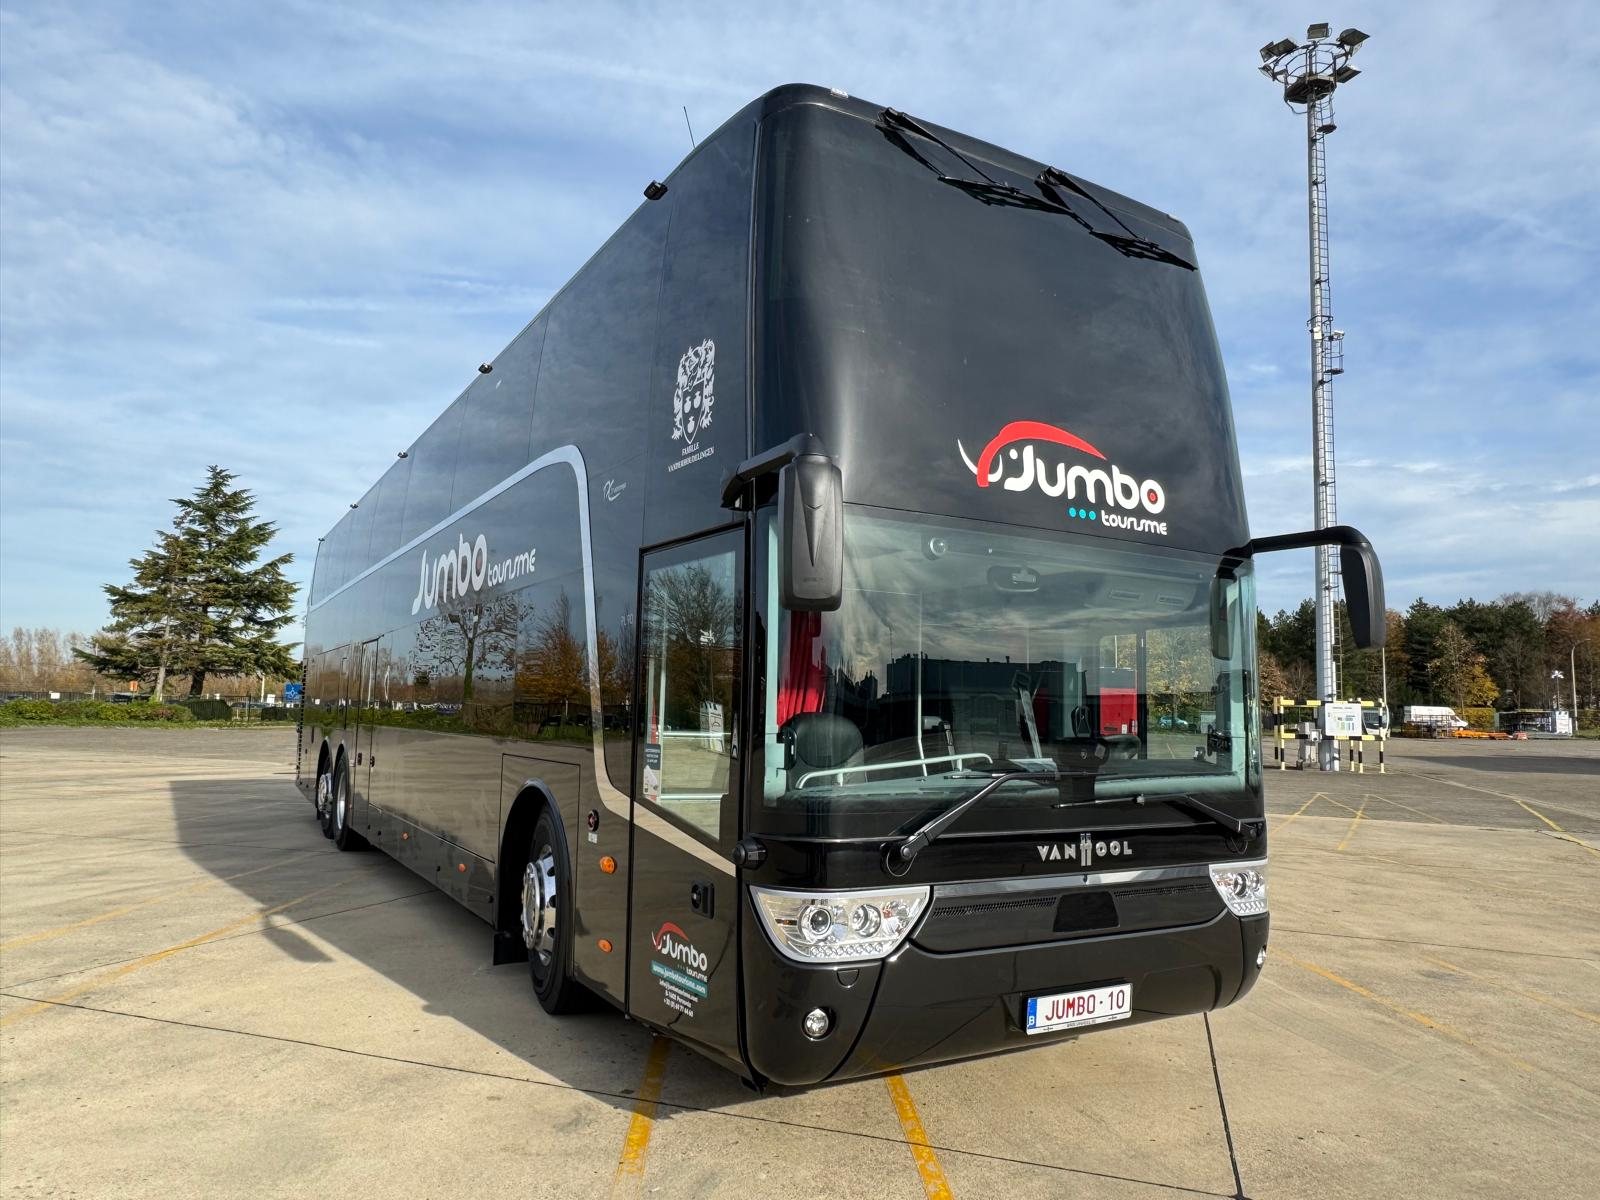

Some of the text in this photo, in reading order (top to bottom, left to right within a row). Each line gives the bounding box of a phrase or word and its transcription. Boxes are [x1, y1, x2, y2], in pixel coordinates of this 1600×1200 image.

[1003, 444, 1166, 514] Jumbo
[411, 533, 488, 616] Jumbo
[661, 933, 708, 971] Jumbo
